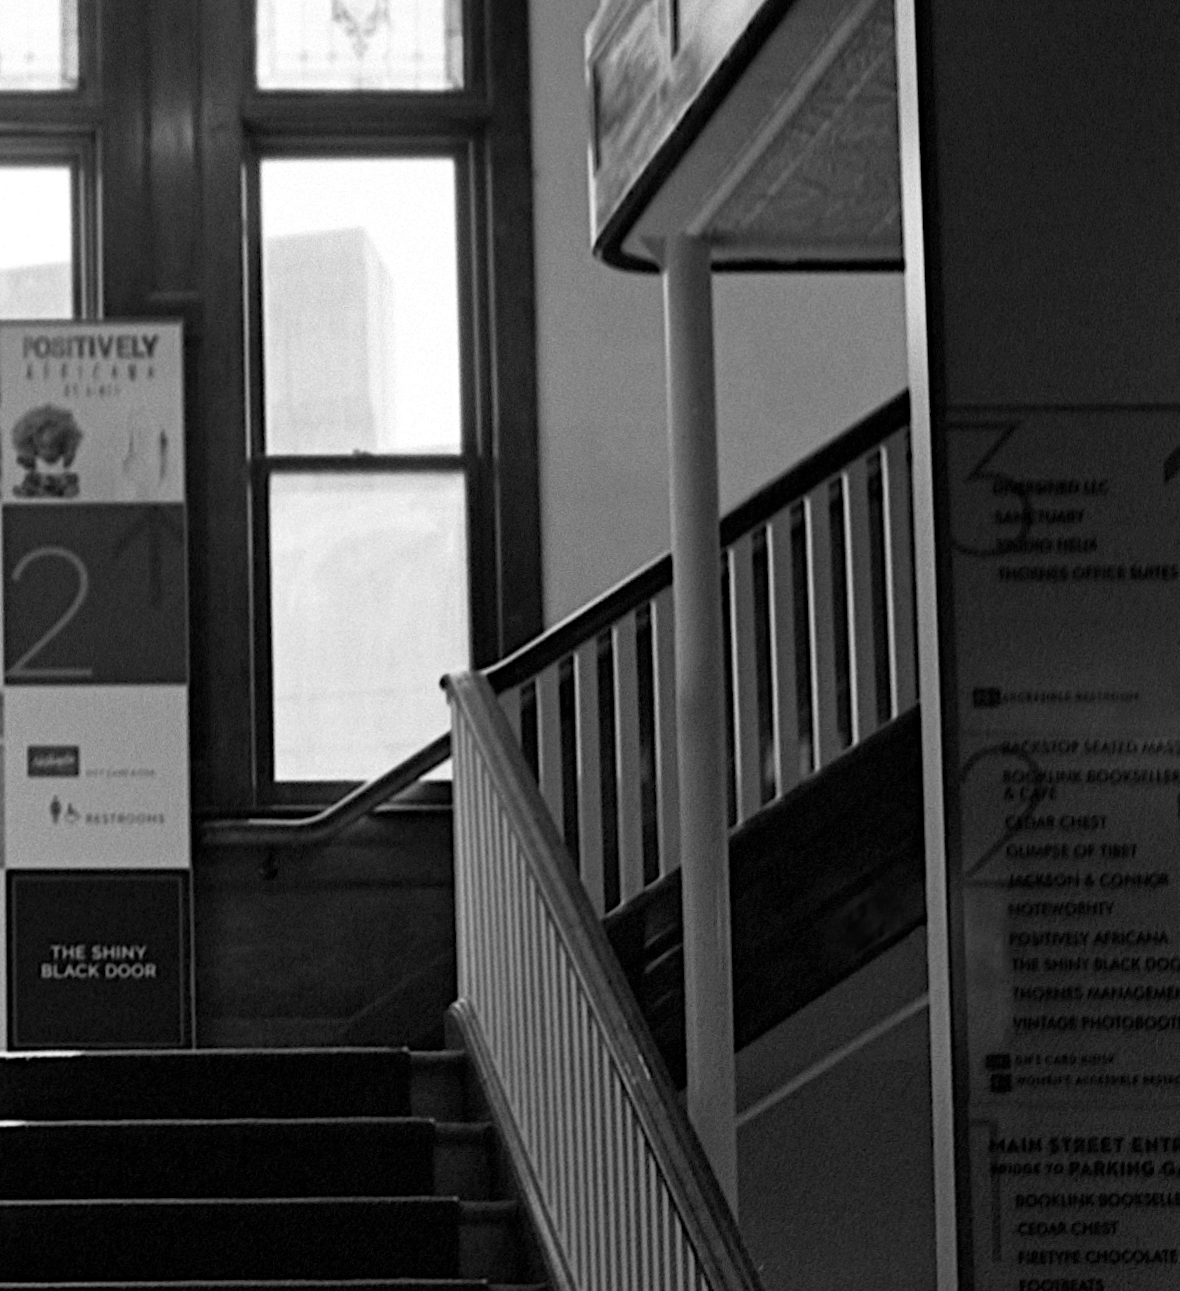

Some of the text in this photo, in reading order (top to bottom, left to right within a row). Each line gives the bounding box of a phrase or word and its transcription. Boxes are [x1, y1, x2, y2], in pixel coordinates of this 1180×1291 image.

[23, 334, 159, 360] POSITIVELY
[5, 546, 93, 678] 2
[1005, 815, 1107, 831] CEDAR CHEST
[1006, 843, 1068, 859] GLIMPSE
[1073, 843, 1095, 859] OF
[1084, 873, 1095, 888] &
[50, 944, 147, 961] THE SHINY
[40, 962, 157, 979] BLACK DOOR
[1013, 957, 1039, 972] THE
[1094, 957, 1141, 972] BLACK
[1013, 1015, 1078, 1031] VINTAGE
[988, 1137, 1042, 1154] MAIN
[1048, 1137, 1124, 1155] STREET
[1068, 1161, 1155, 1178] PARKING
[1016, 1193, 1094, 1209] BOOKLINK
[1017, 1221, 1119, 1237] CEDAR CHEST
[1085, 1248, 1178, 1265] CHOCOLATE
